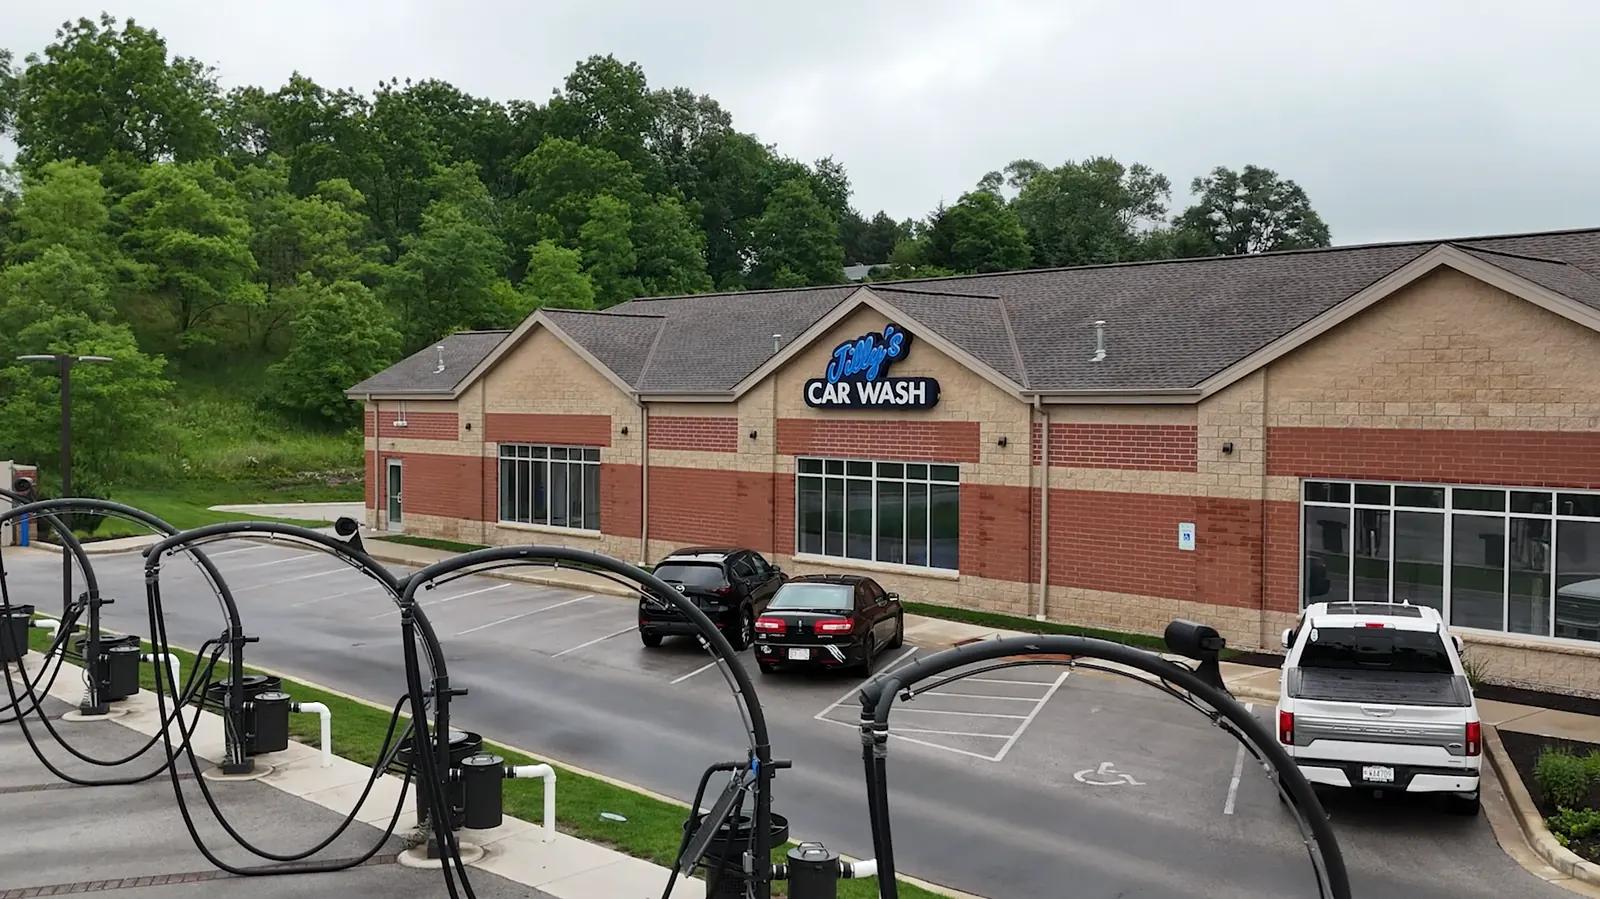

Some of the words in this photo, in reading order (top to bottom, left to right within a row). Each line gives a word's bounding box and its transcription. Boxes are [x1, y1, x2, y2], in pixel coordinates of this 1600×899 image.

[827, 326, 904, 384] Jilly's
[808, 382, 851, 404] CAR
[856, 381, 926, 405] WASH
